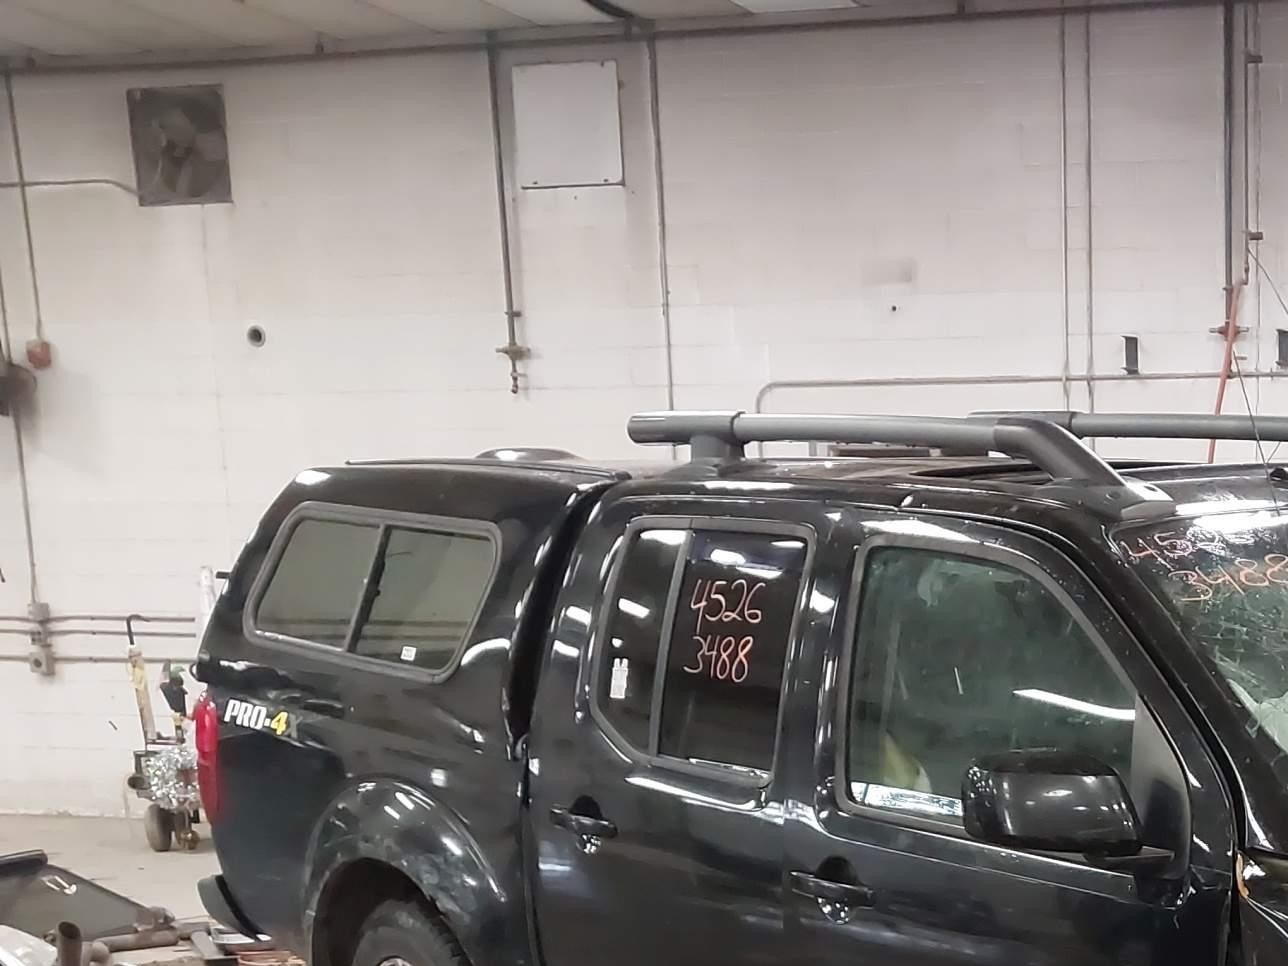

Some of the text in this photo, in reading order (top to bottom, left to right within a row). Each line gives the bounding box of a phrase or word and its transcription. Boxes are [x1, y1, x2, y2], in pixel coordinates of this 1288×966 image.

[690, 579, 766, 634] 4526
[684, 635, 754, 683] 3488
[223, 698, 303, 739] PRO-4X
